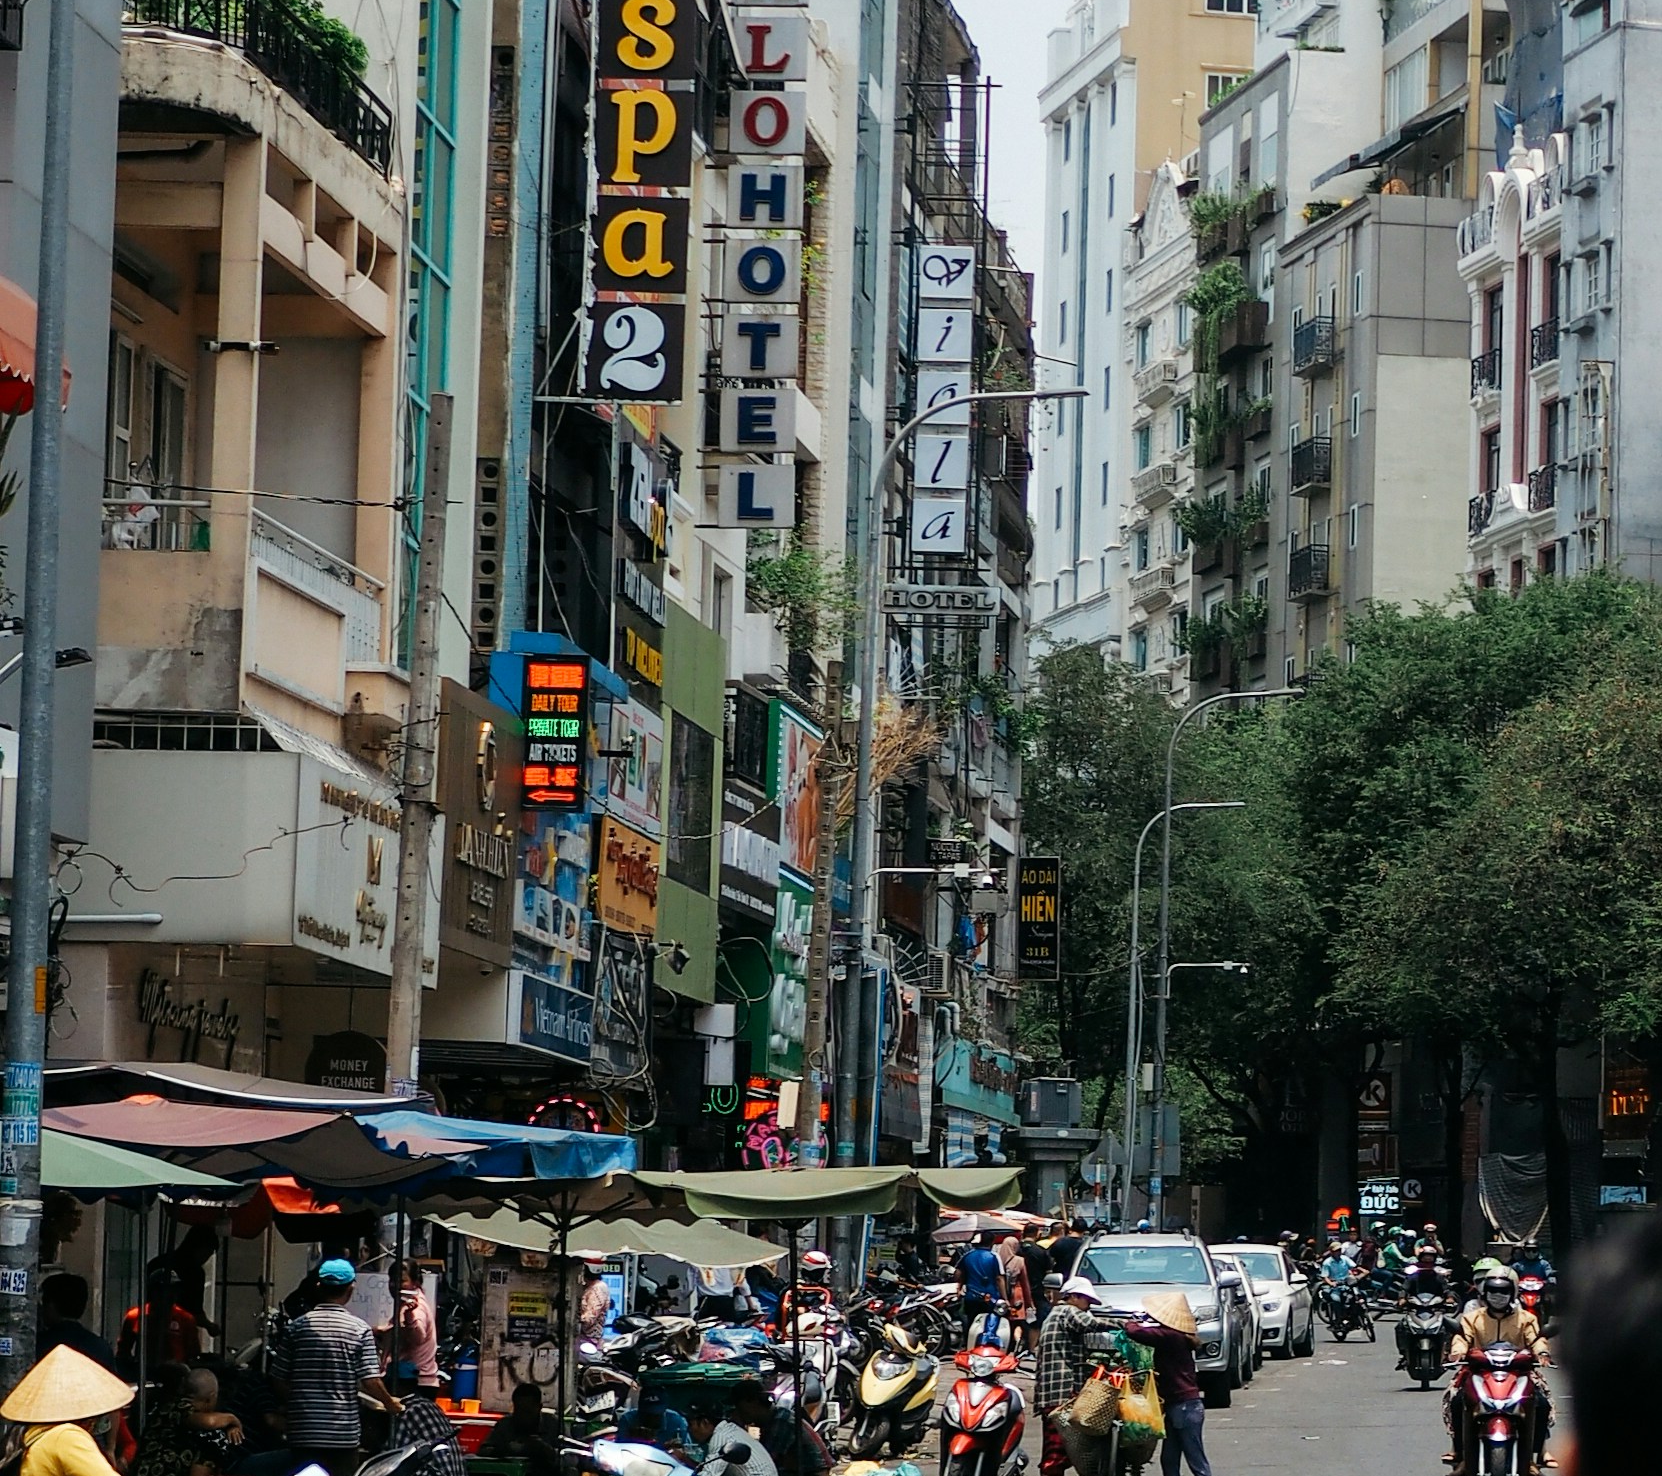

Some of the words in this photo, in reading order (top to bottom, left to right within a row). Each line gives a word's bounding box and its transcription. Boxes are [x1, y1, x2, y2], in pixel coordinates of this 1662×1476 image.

[600, 304, 667, 393] 2
[737, 172, 788, 521] HOTEL
[884, 589, 996, 612] HOTEL
[531, 693, 556, 712] DAILY
[556, 694, 579, 713] TOUR
[560, 718, 580, 738] TOUR
[528, 743, 543, 762] AIR
[1021, 889, 1056, 922] HIỀN
[1026, 946, 1050, 957] 31B
[330, 1058, 368, 1072] MONEY
[321, 1075, 376, 1090] EXCHANGE
